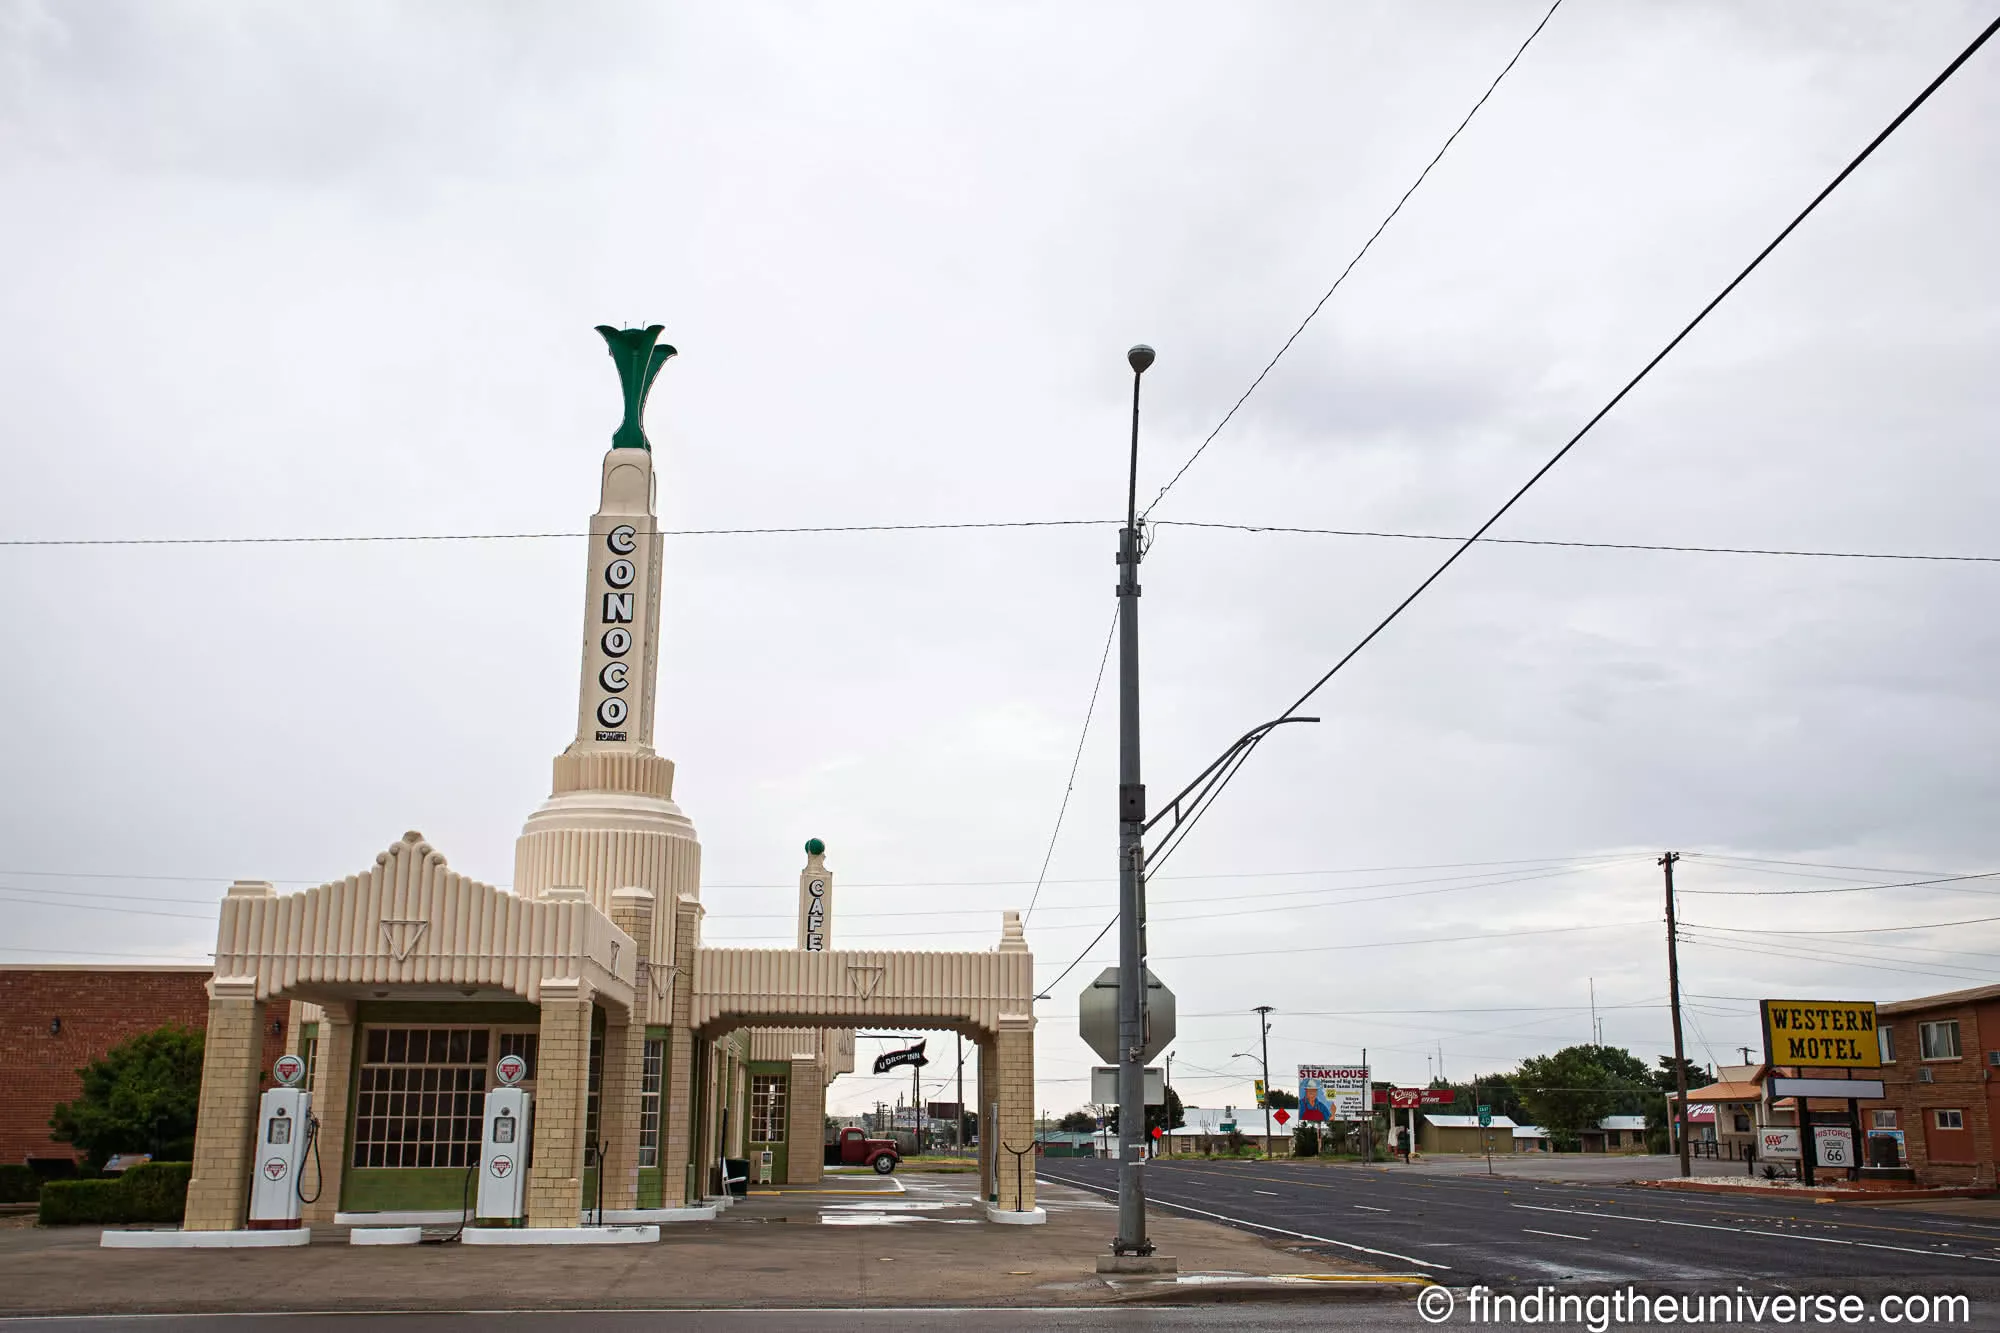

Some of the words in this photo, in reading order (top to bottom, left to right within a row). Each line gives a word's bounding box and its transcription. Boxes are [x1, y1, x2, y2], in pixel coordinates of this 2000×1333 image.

[597, 525, 636, 728] CONOCO
[807, 879, 824, 951] CAFE
[1771, 1008, 1873, 1031] WESTERN
[907, 1052, 920, 1060] INN
[1787, 1037, 1862, 1060] MOTEL
[1815, 1129, 1852, 1139] HISTORIC
[1826, 1150, 1843, 1161] 66
